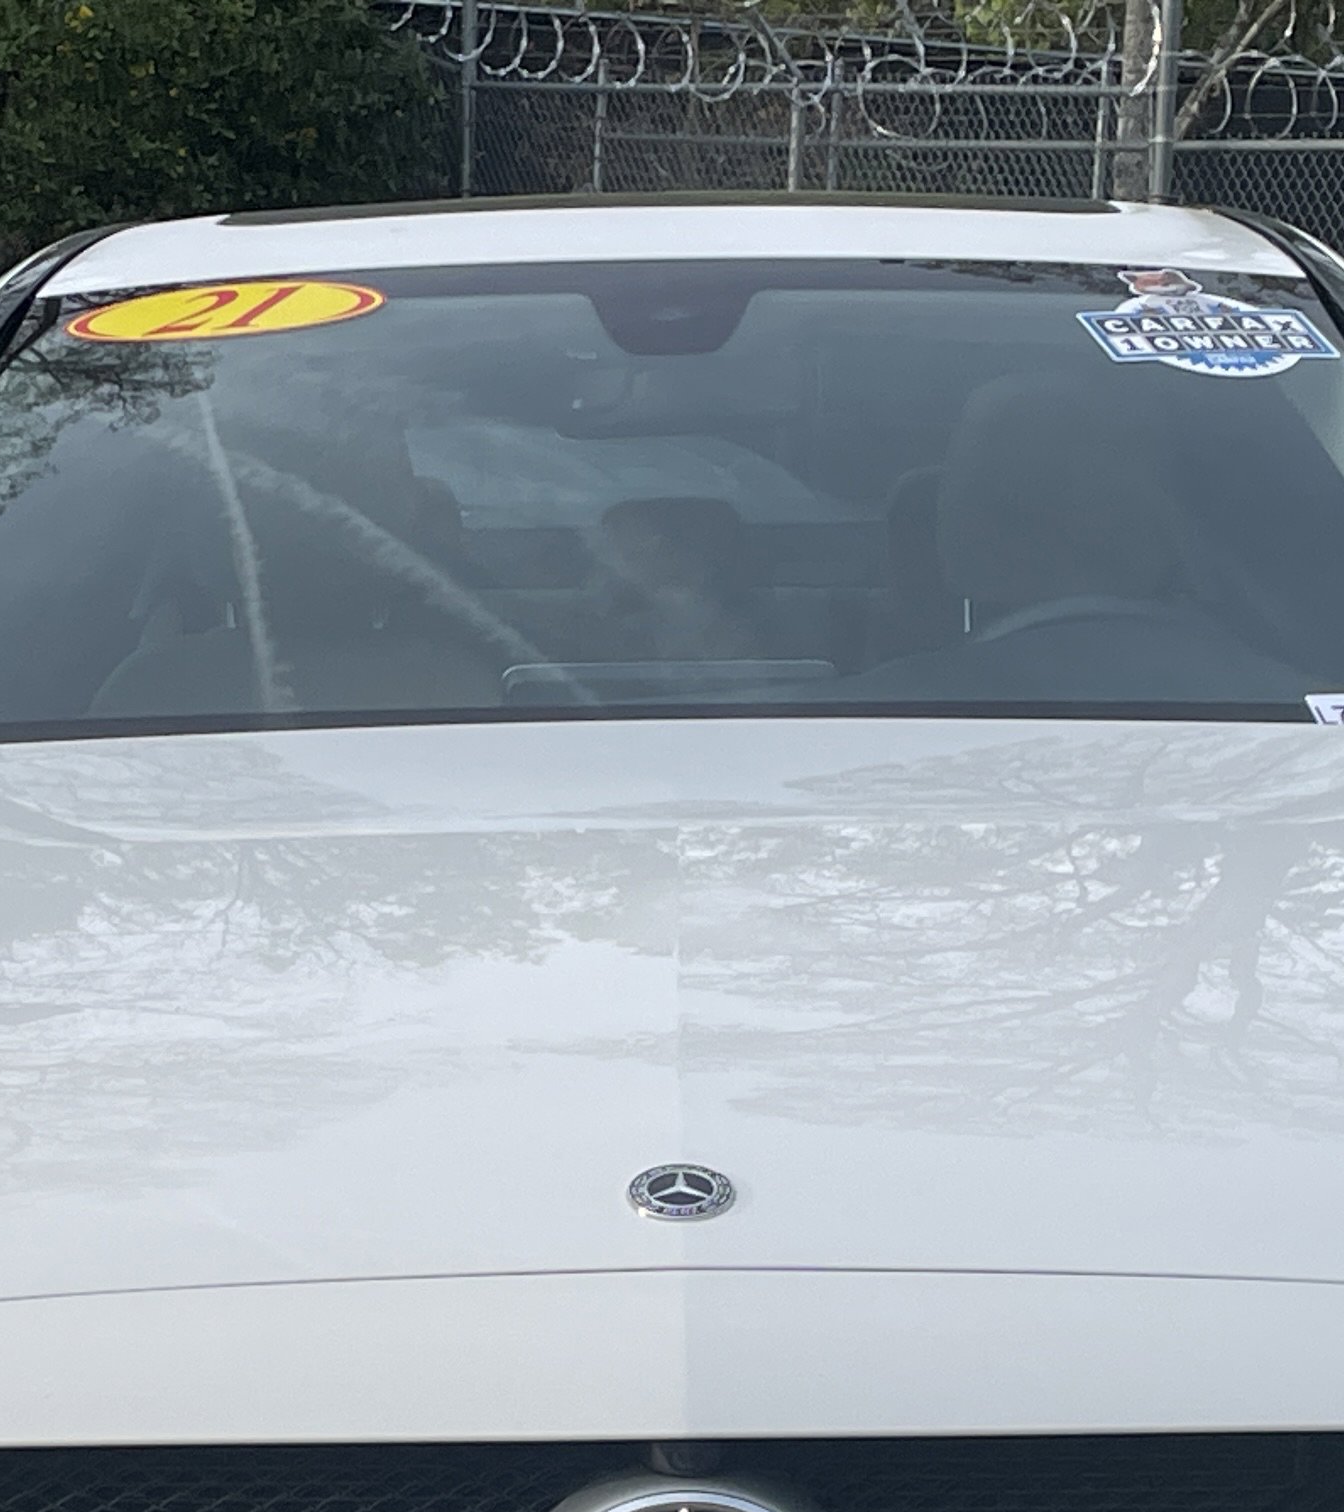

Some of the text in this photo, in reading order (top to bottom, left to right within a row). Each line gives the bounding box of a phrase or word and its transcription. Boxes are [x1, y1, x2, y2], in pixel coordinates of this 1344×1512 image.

[141, 285, 306, 336] 21
[1103, 316, 1306, 334] CARFAX
[1120, 336, 1314, 351] 1 OWNER
